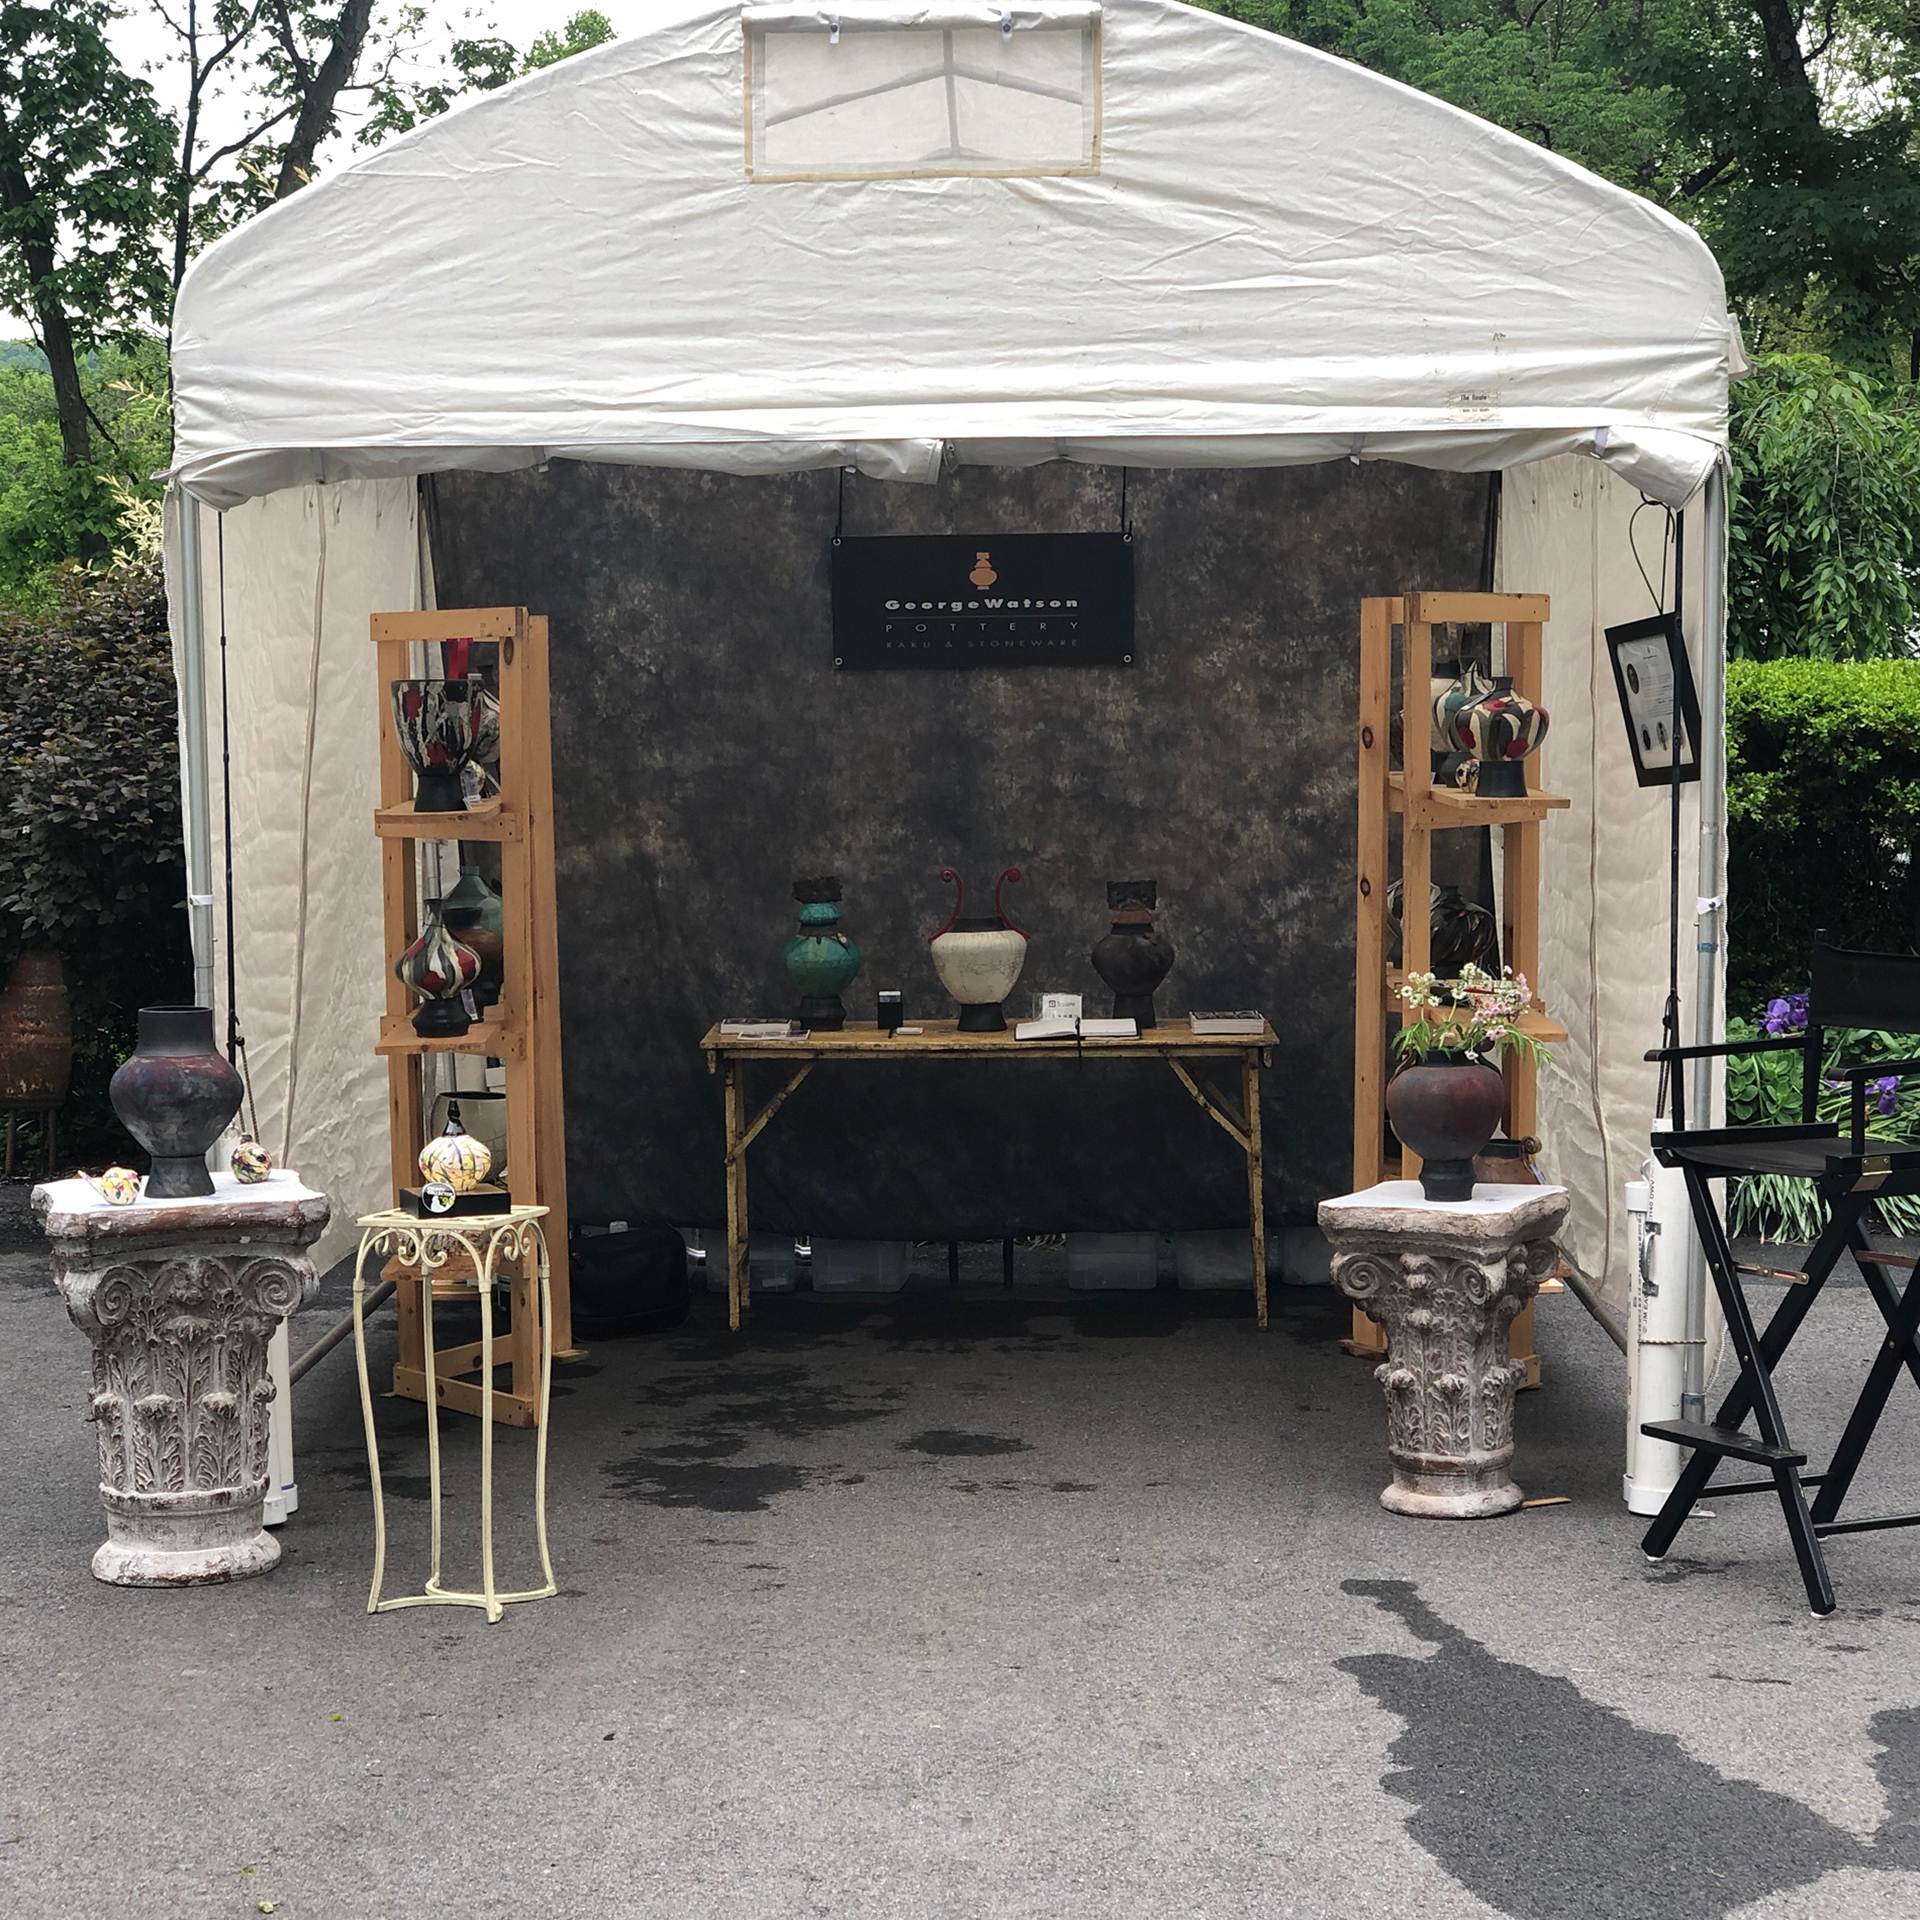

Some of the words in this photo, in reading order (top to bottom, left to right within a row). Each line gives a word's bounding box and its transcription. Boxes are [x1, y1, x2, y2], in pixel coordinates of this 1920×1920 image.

[885, 622, 1078, 632] POTTERY
[886, 641, 931, 649] RAKU
[968, 640, 1077, 648] STONEWARE
